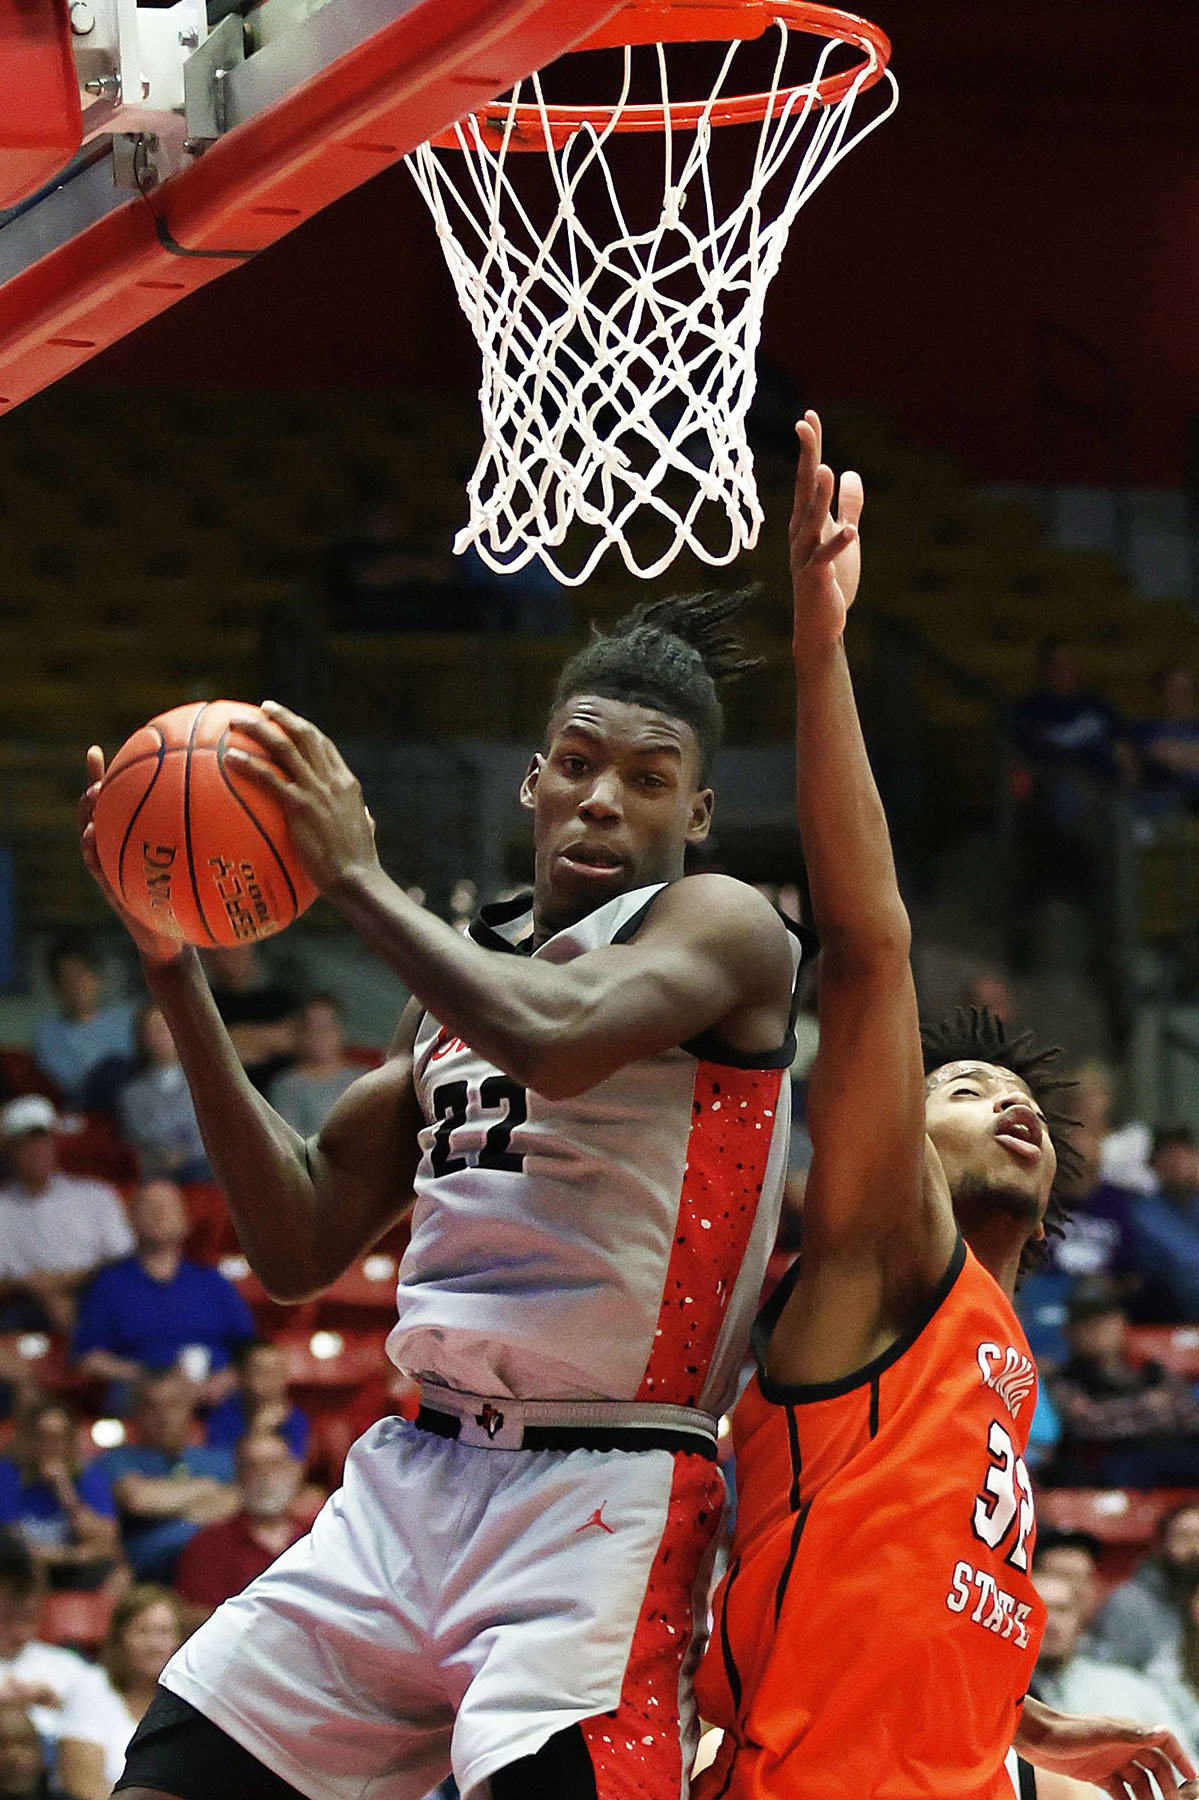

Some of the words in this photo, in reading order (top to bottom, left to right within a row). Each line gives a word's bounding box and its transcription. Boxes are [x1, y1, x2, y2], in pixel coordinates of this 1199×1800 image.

[431, 1074, 528, 1178] 22
[971, 1418, 1036, 1574] 32
[946, 1559, 1031, 1651] STATE
